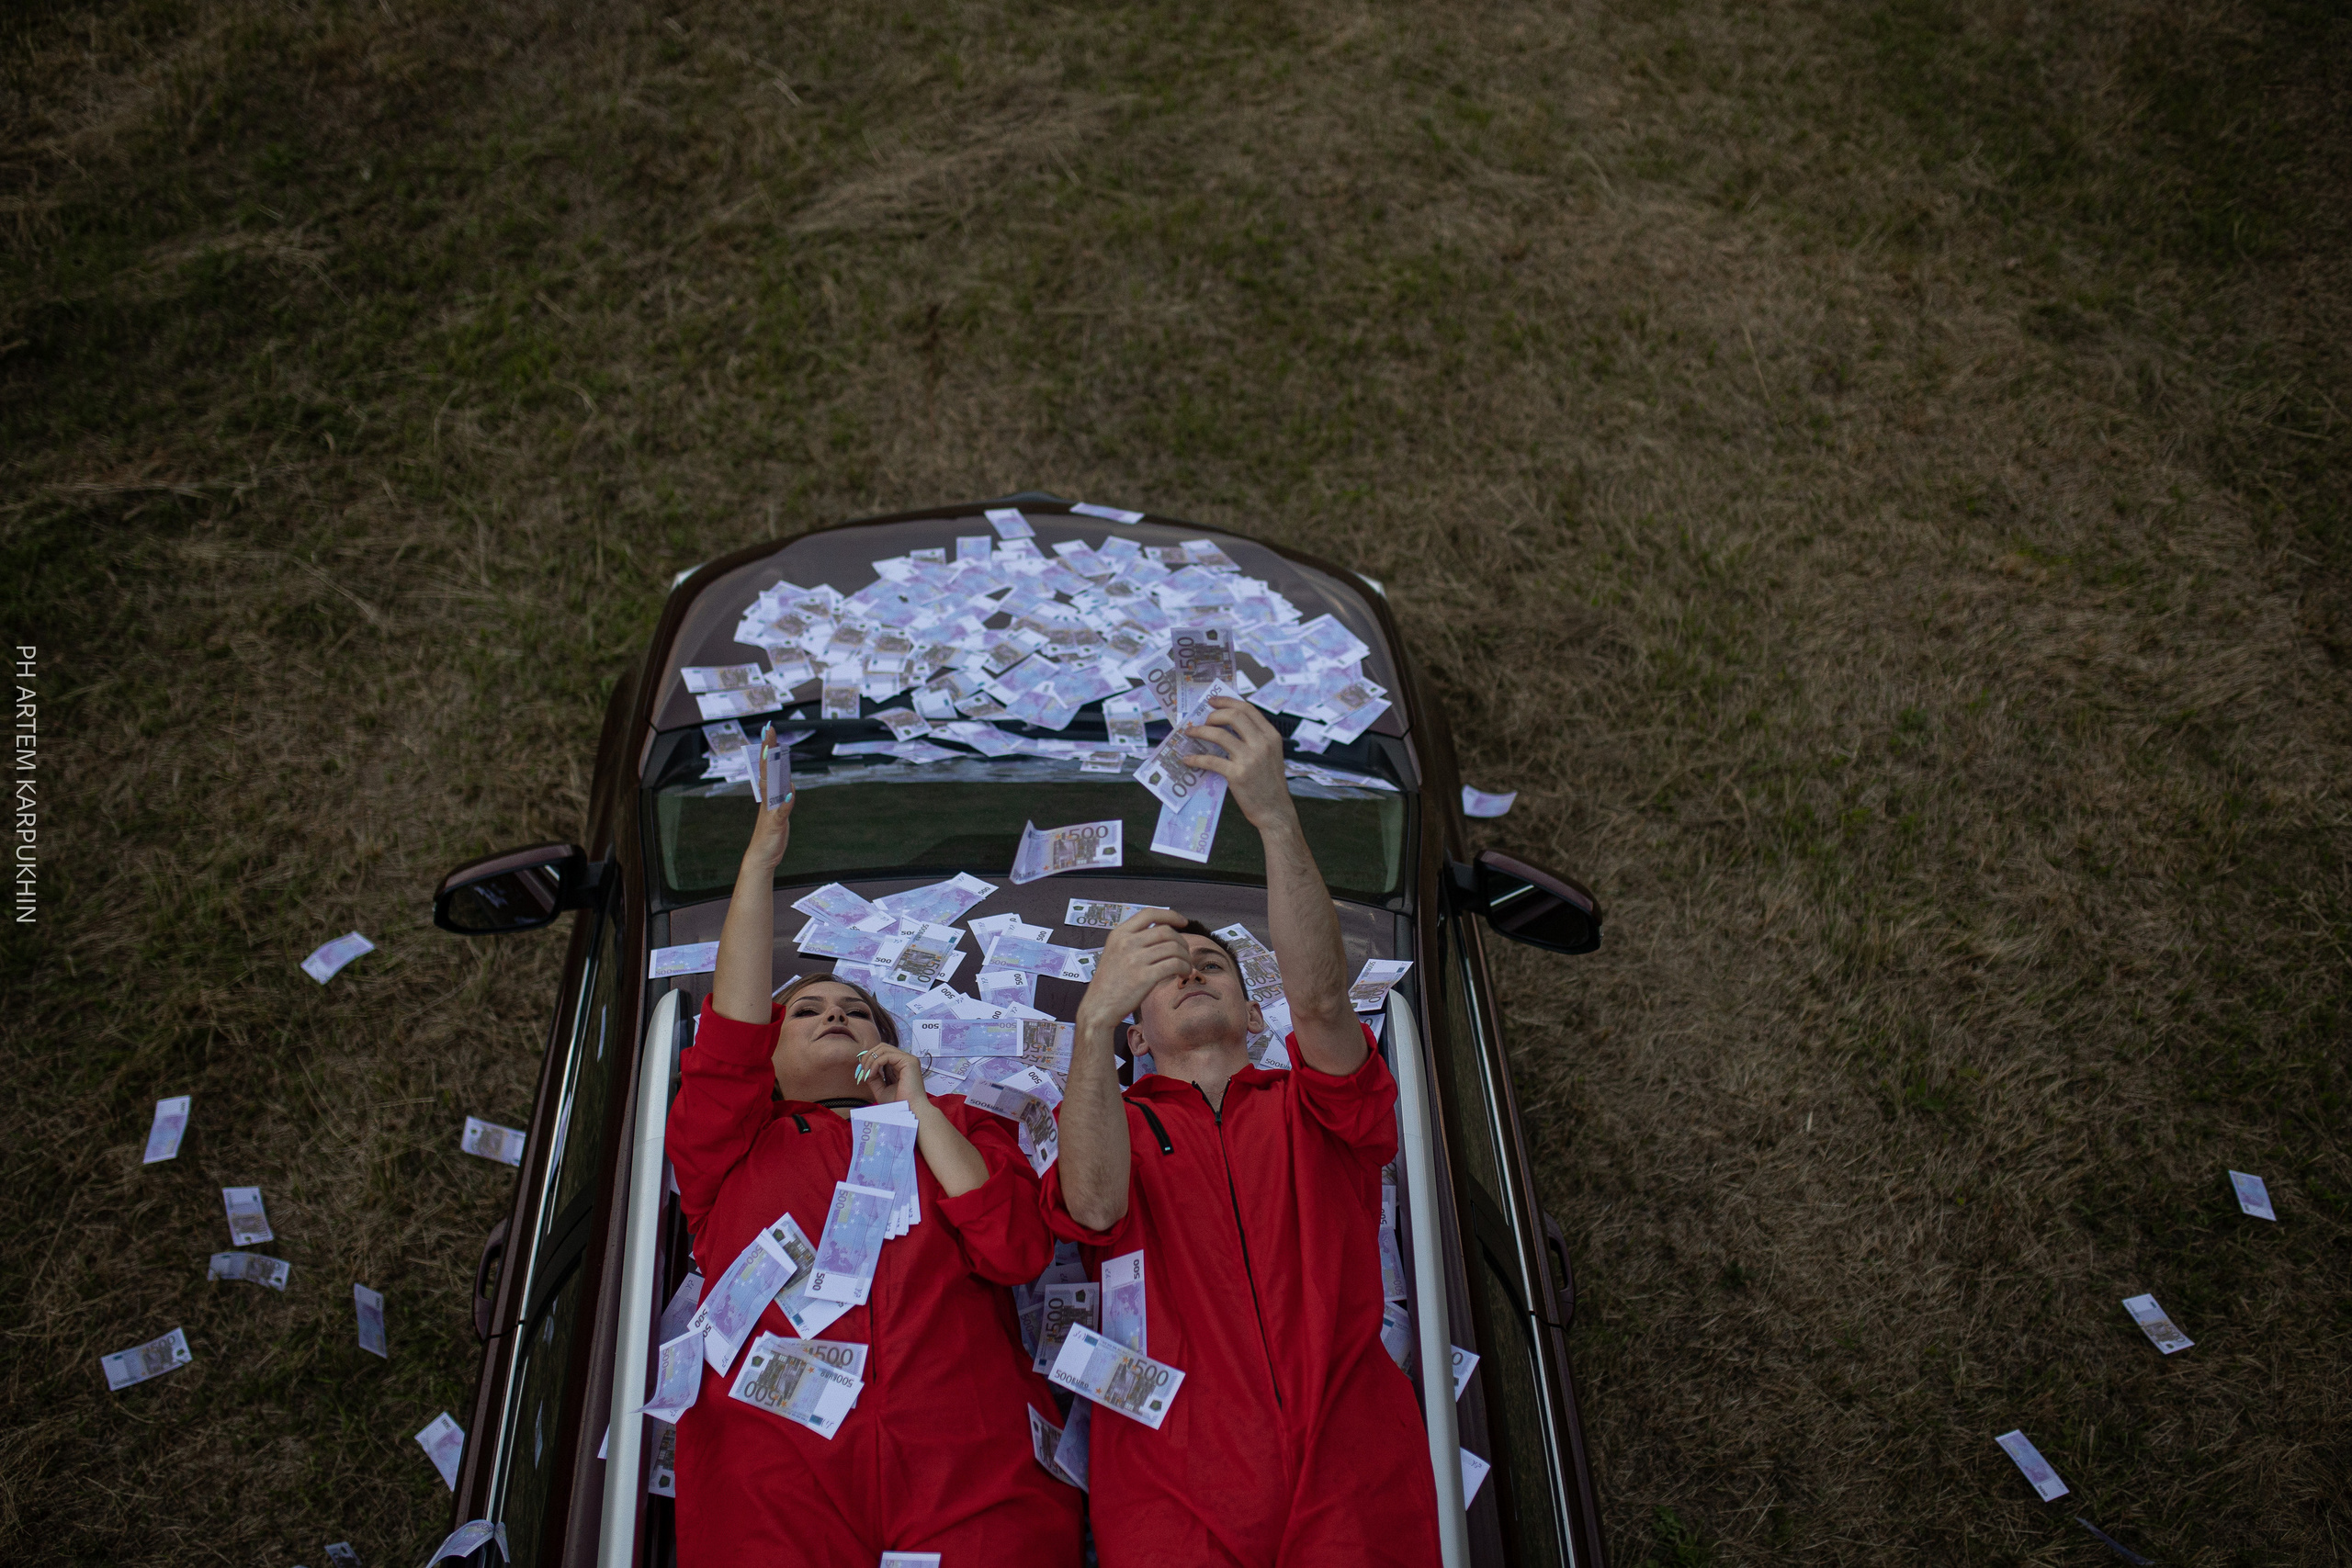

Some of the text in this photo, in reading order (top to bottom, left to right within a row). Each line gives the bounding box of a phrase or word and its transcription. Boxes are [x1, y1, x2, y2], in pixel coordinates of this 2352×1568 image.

[1176, 636, 1194, 669] 500
[1148, 669, 1177, 707] 500
[1069, 825, 1109, 841] 500
[1196, 832, 1210, 854] 500
[1076, 917, 1108, 928] 500
[1036, 931, 1047, 942] 500
[875, 956, 892, 964] 500
[917, 961, 941, 983] 500
[1014, 973, 1023, 986] 500
[1245, 974, 1278, 987] 500
[941, 987, 956, 1000] 500
[1250, 987, 1283, 1003] 500
[991, 1010, 1002, 1020] 00
[1028, 1071, 1043, 1085] 500
[861, 1120, 873, 1142] 500
[1040, 1104, 1057, 1143] 500
[835, 1189, 849, 1210] 500
[746, 1244, 763, 1266] 500
[813, 1271, 825, 1292] 500
[694, 1308, 708, 1328] 500
[1046, 1297, 1064, 1334] 500
[703, 1323, 712, 1338] 50
[815, 1346, 854, 1366] 500
[1132, 1359, 1170, 1387] 500
[743, 1380, 776, 1407] 500
